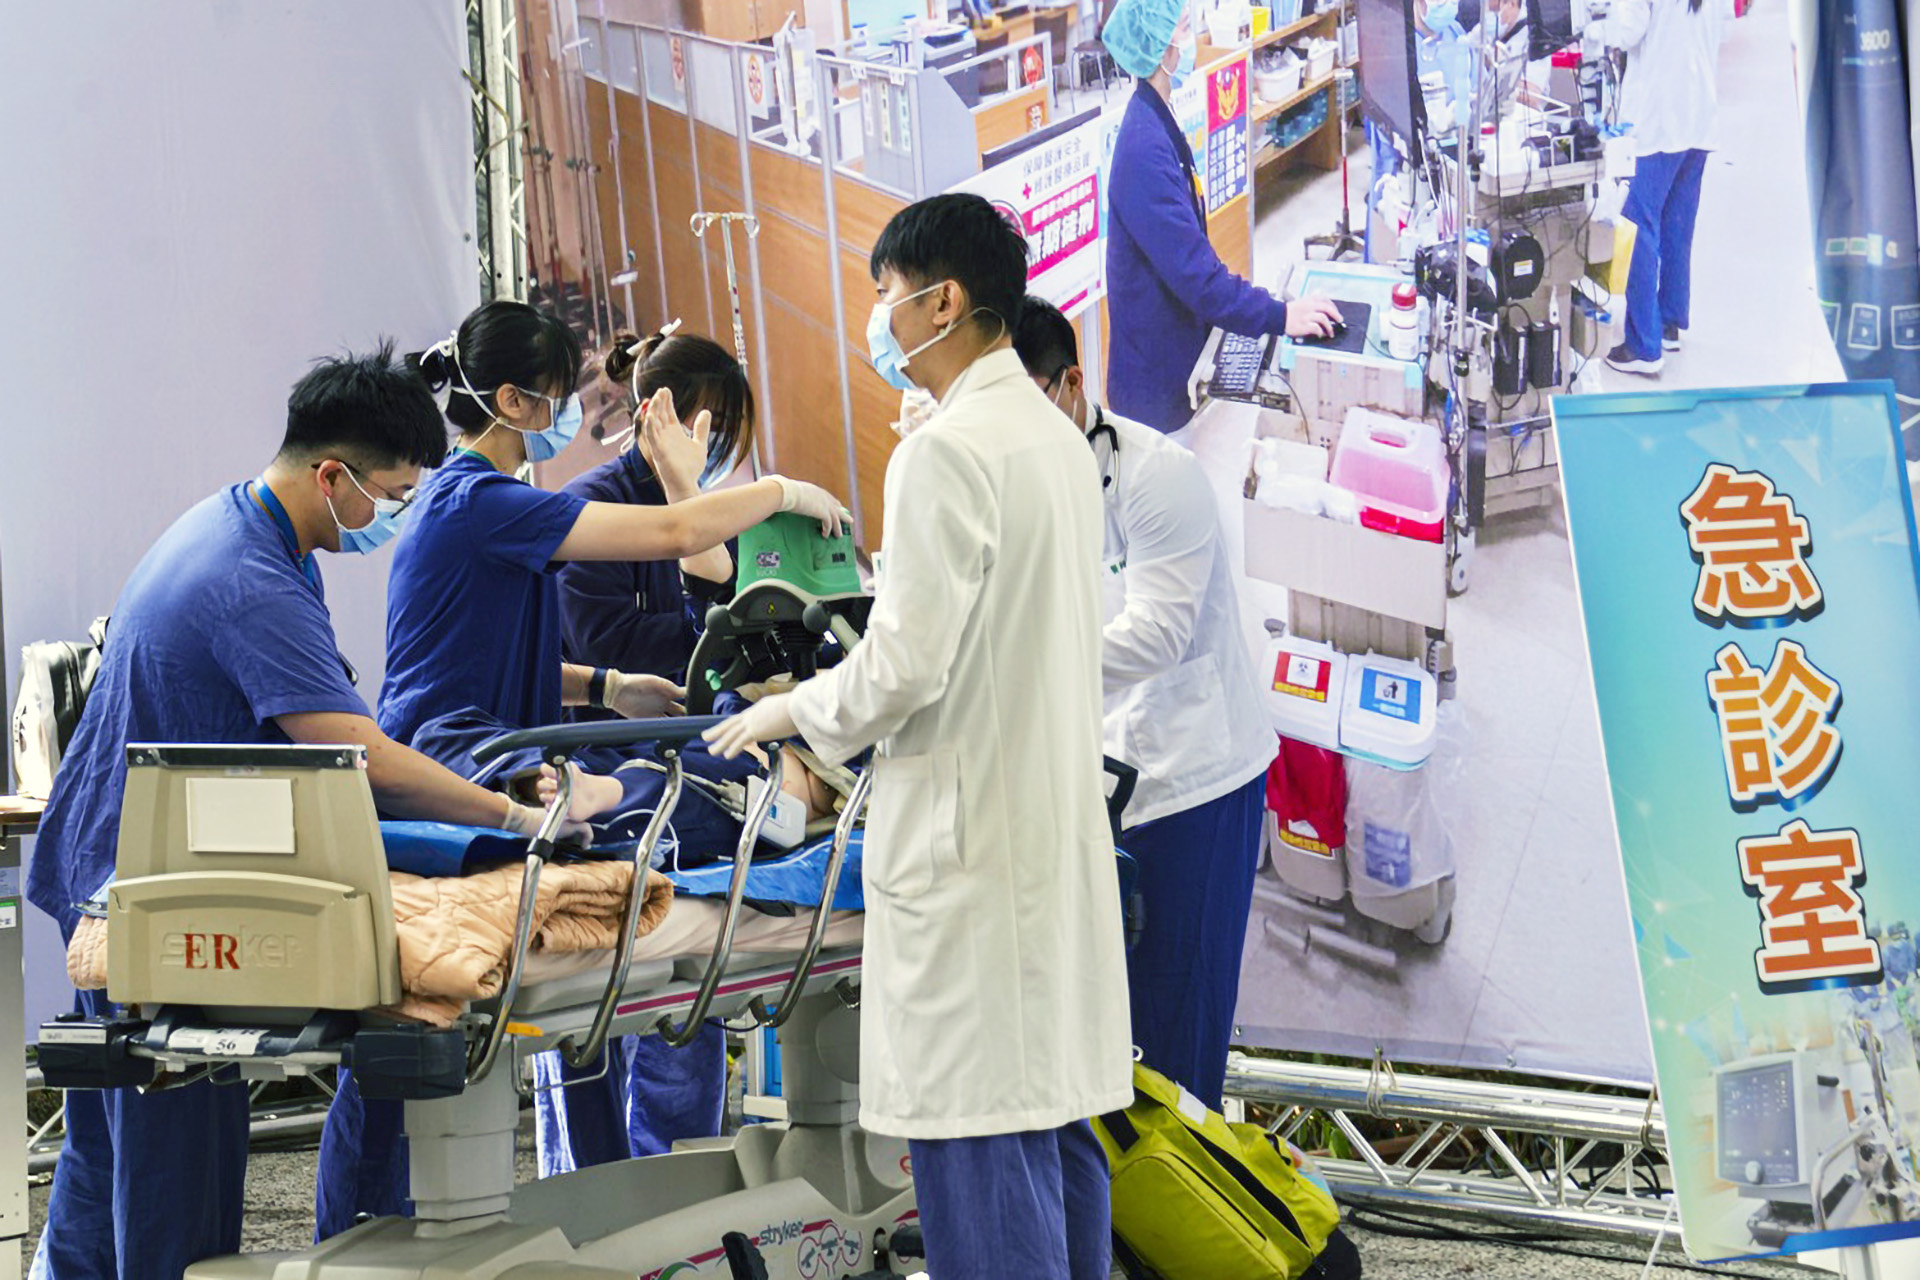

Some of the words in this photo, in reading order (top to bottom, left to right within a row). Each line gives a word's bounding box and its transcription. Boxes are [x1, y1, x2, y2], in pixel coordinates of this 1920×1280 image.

[1683, 467, 1879, 980] 急診室
[184, 933, 241, 970] ER
[216, 1038, 237, 1051] 56
[759, 1218, 804, 1247] stryker
